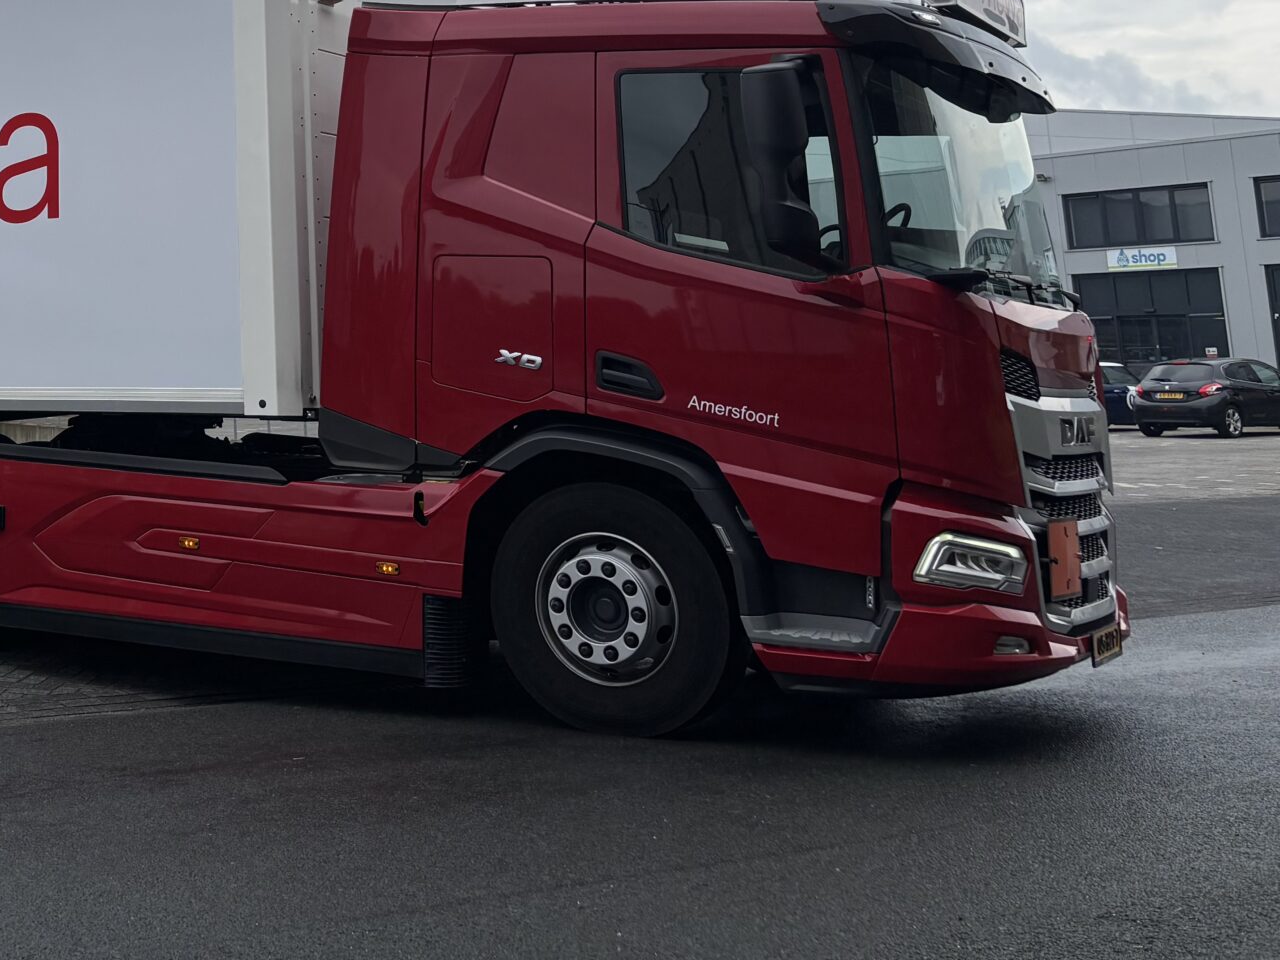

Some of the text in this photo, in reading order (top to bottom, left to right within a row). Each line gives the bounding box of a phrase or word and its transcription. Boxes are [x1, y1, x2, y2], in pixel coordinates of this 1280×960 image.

[1131, 249, 1167, 266] shop
[494, 348, 543, 370] XD
[687, 395, 780, 428] Amersfoort
[1059, 416, 1097, 448] DAF
